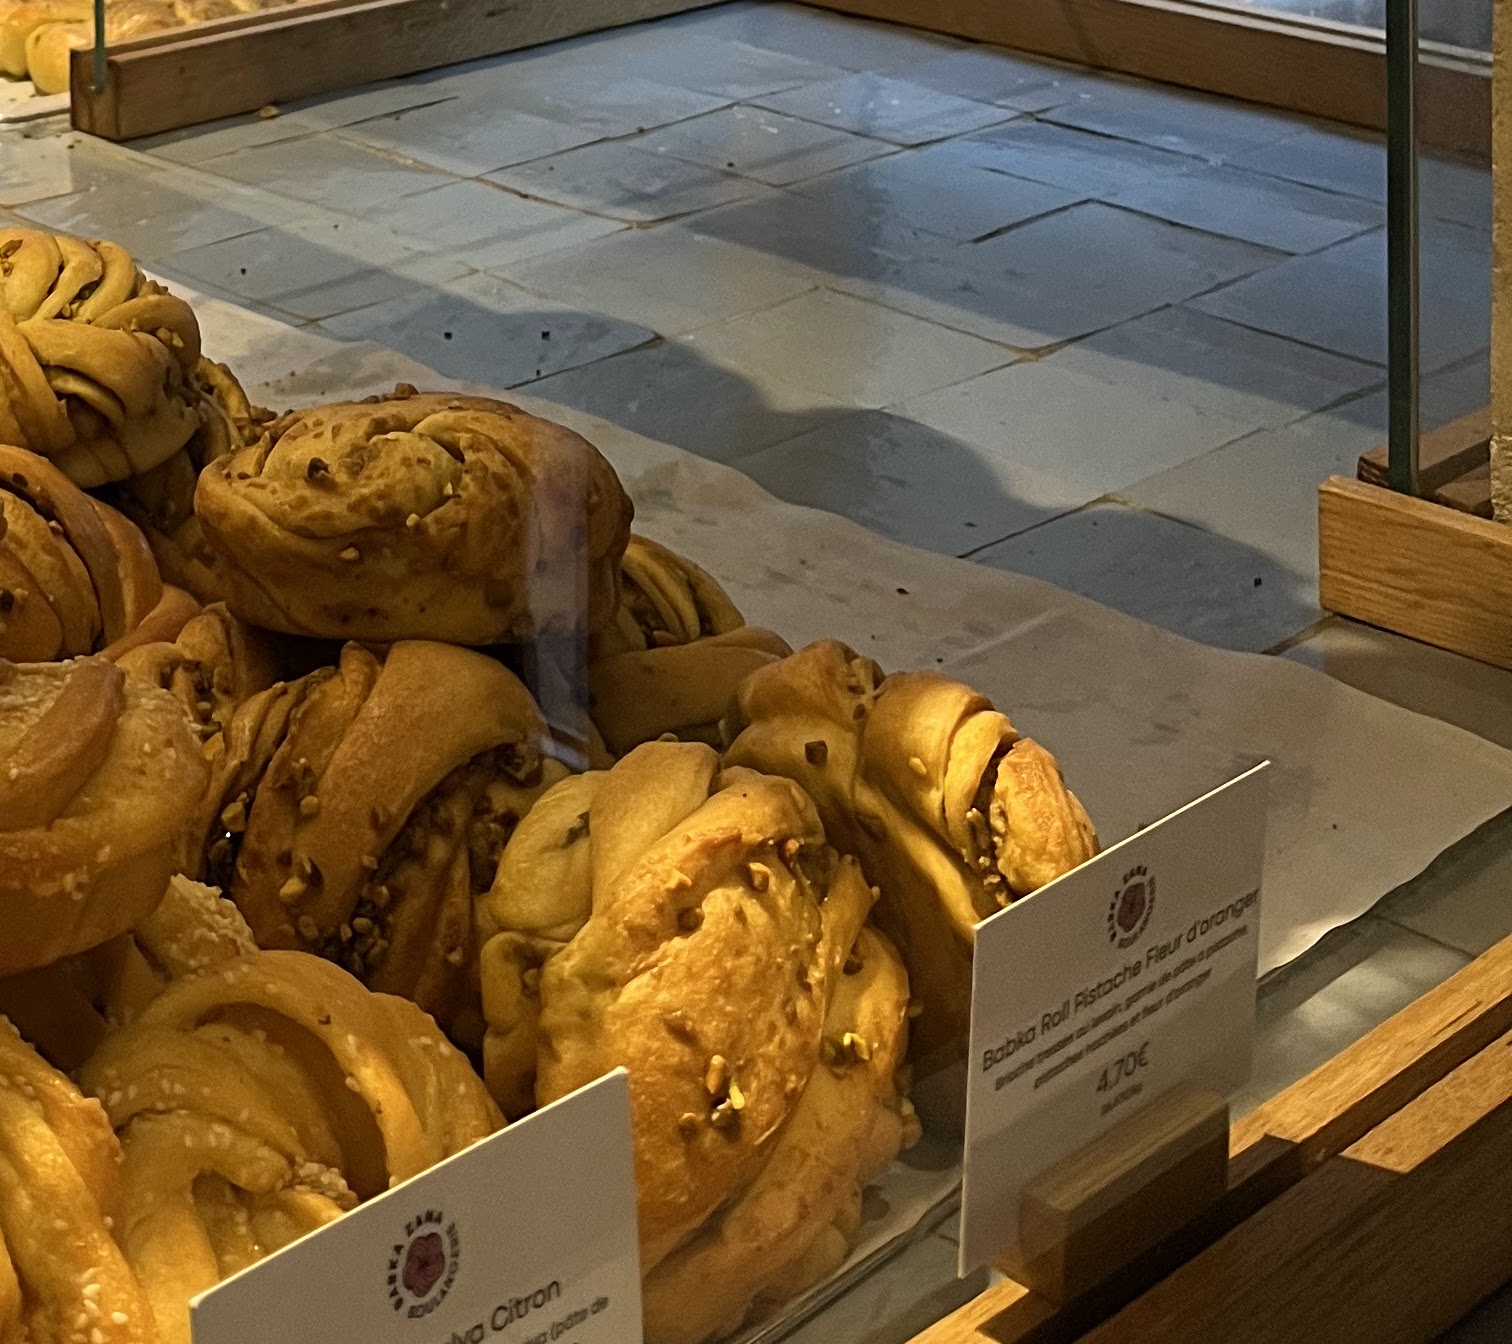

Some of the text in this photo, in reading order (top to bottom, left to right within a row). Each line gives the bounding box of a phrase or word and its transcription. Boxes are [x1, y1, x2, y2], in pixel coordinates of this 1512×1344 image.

[983, 1024, 1037, 1072] Babka
[1040, 998, 1070, 1035] Roll
[1074, 960, 1142, 1013] Pistache
[1146, 933, 1183, 969] Fleur
[1186, 888, 1260, 943] d'oranger
[490, 1280, 561, 1332] Citron
